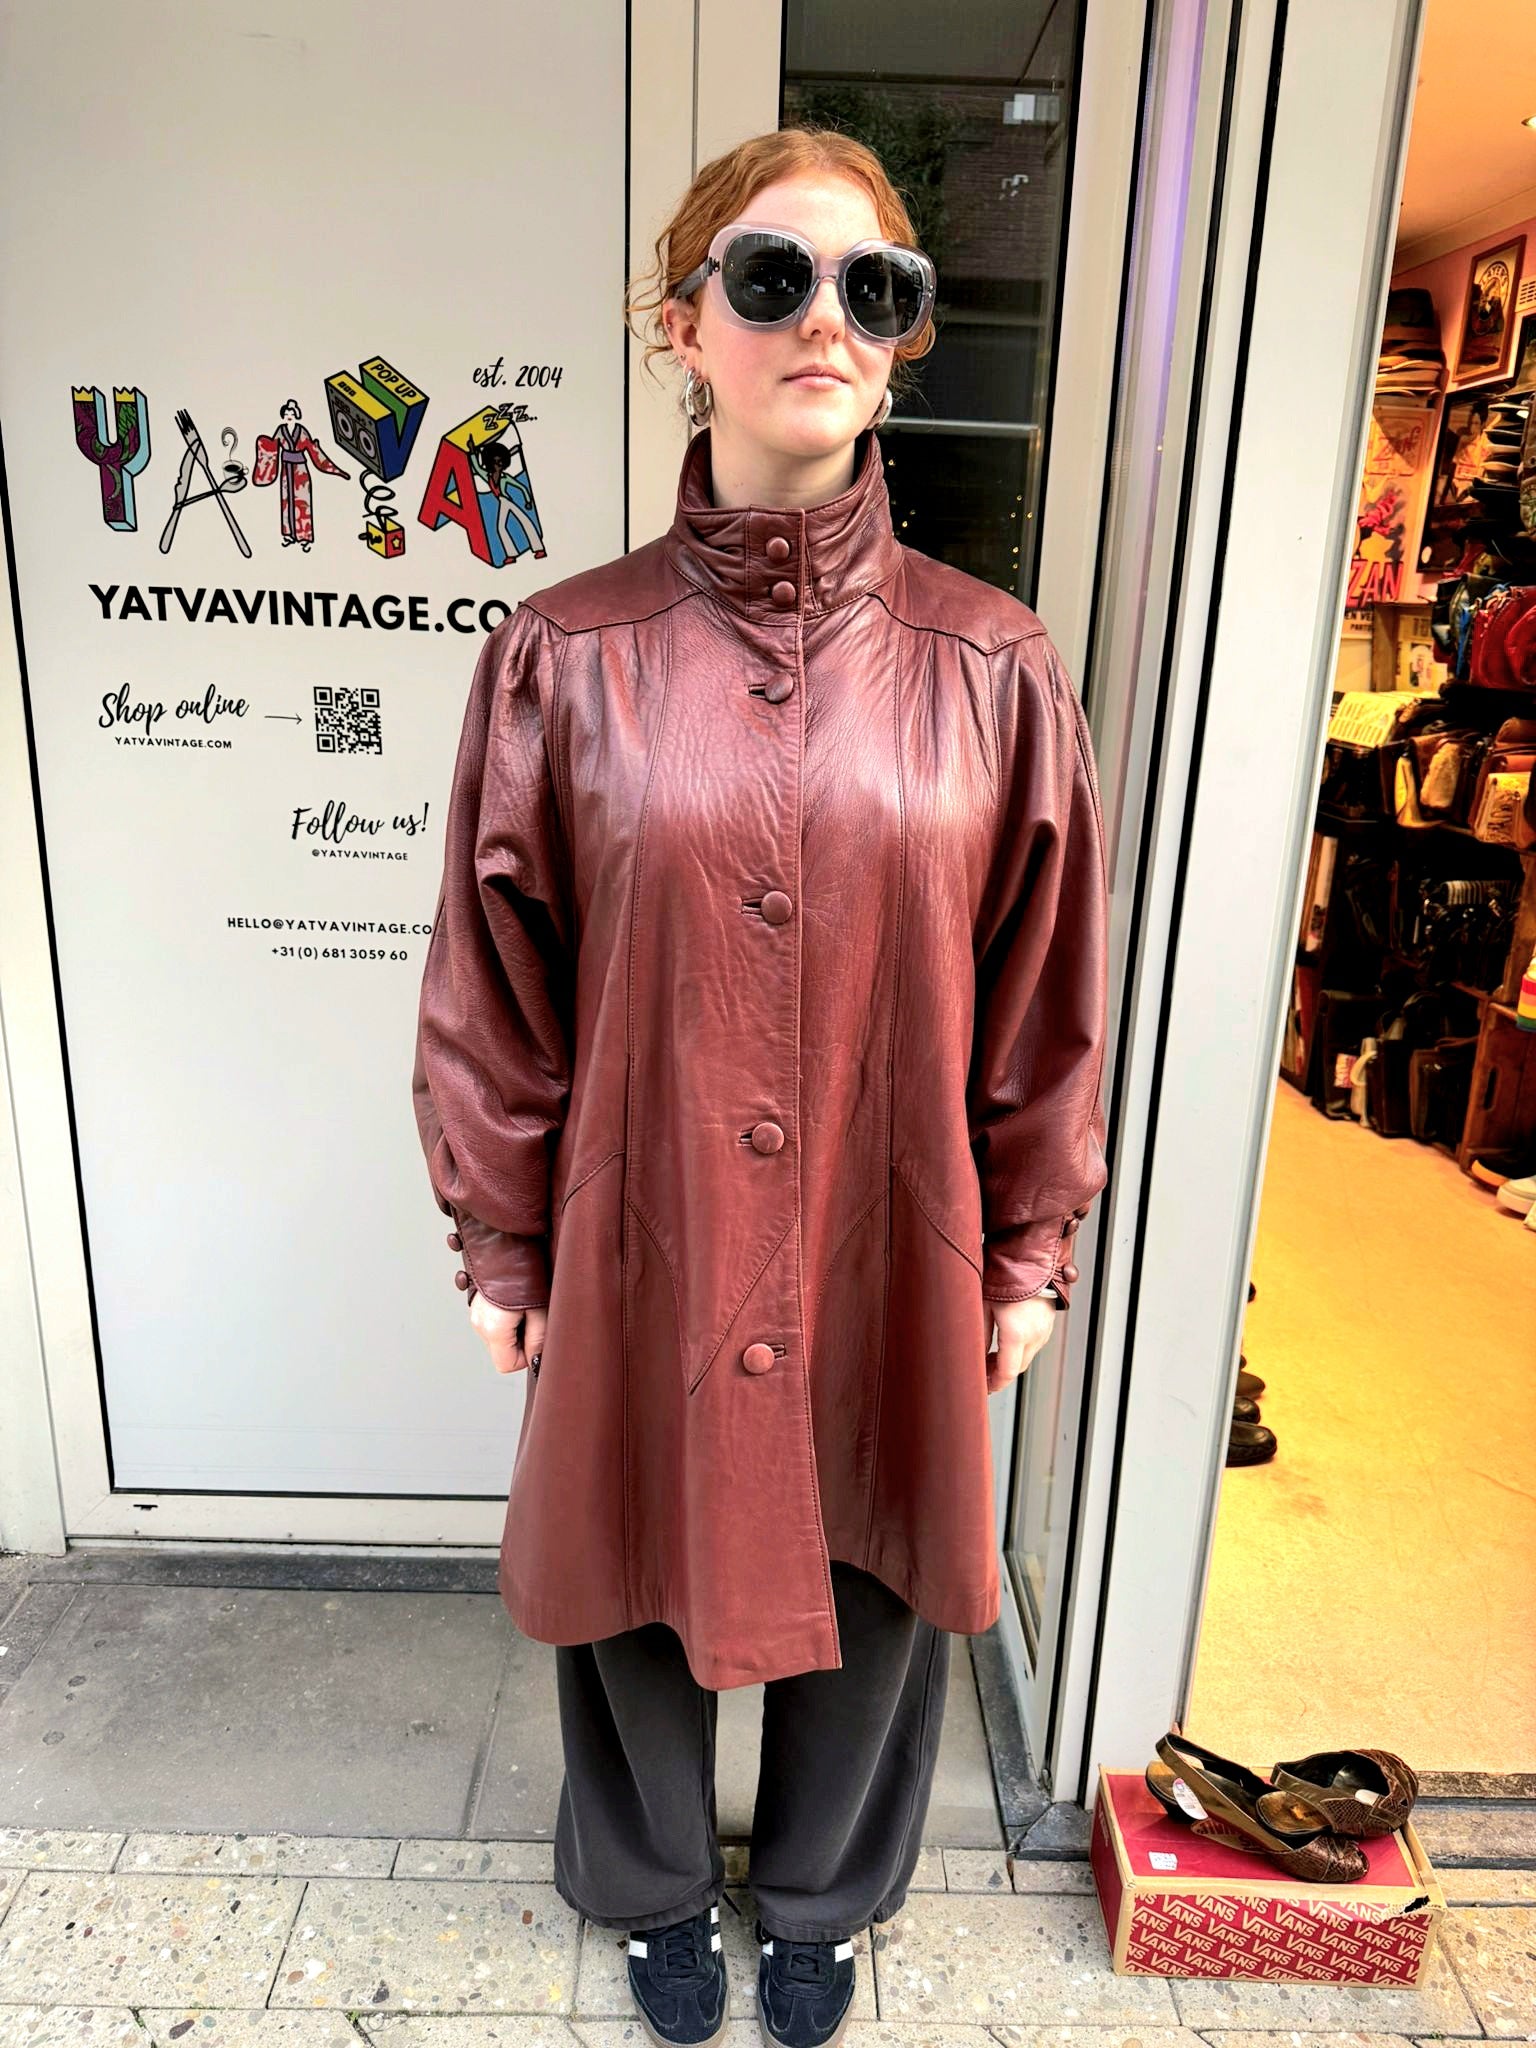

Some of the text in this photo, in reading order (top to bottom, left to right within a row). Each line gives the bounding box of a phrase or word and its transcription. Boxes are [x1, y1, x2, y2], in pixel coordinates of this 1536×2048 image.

[370, 364, 417, 398] POP UP
[473, 357, 564, 389] est. 2004
[89, 584, 512, 633] YATVAVINTAGE.CO
[99, 683, 250, 735] Shop online
[115, 737, 232, 749] YATVAVINTAGE.COM
[291, 800, 430, 844] Follow us!
[312, 849, 408, 861] @YATVAVINTAGE
[227, 917, 432, 935] HELLO@YATVAVINTAGE.CO
[1163, 1895, 1206, 1928] VANS
[1196, 1895, 1239, 1922] VANS
[1275, 1903, 1320, 1937] VANS
[1309, 1900, 1353, 1931] VANS
[1174, 1924, 1217, 1952] VANS
[1207, 1917, 1251, 1947] VANS
[1242, 1910, 1286, 1942] VANS
[1354, 1922, 1397, 1950] VANS
[1388, 1919, 1428, 1943] VANS
[1140, 1928, 1183, 1956] VANS
[1252, 1939, 1295, 1965] VANS
[1286, 1934, 1329, 1960] VANS
[1320, 1928, 1363, 1955] VANS
[1184, 1948, 1227, 1974] VANS
[1219, 1943, 1262, 1970] VANS
[1296, 1957, 1338, 1980] VANS
[1330, 1952, 1372, 1976] VANS
[1364, 1947, 1406, 1972] VANS
